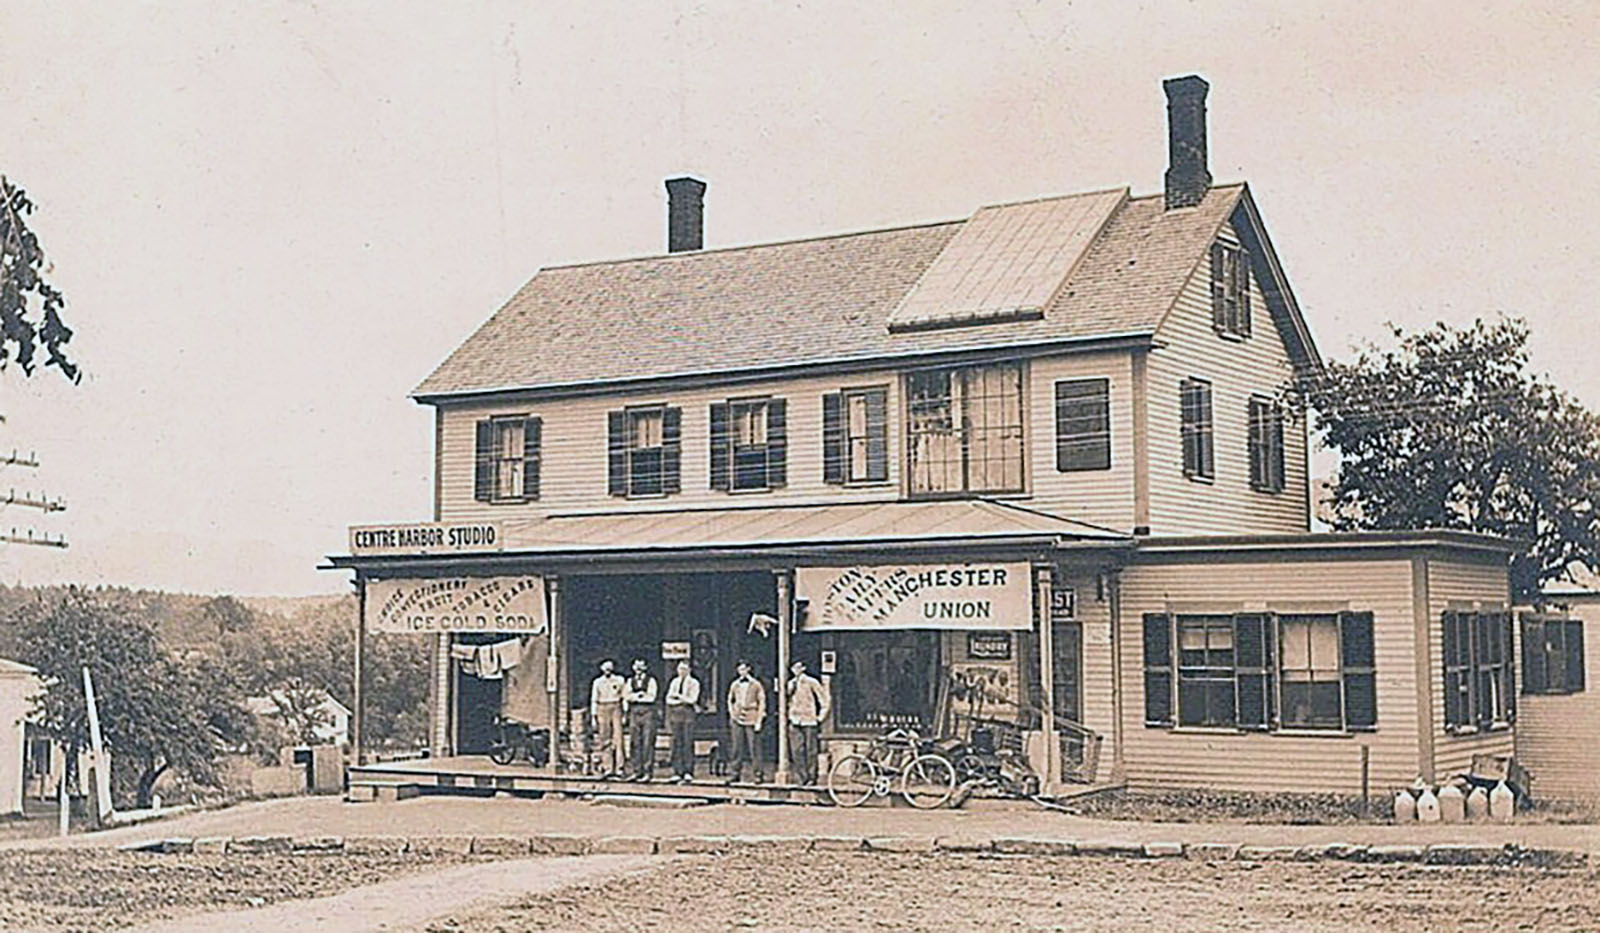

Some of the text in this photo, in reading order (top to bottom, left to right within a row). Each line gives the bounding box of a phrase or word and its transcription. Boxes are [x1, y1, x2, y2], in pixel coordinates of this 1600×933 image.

[355, 526, 496, 548] CENTRE HARBOR STUDIO
[452, 580, 501, 614] TOBACCO
[493, 579, 534, 613] CIGARS
[873, 568, 1008, 625] MANCHESTER
[923, 601, 991, 619] UNION
[407, 615, 435, 630] ICE
[440, 615, 487, 630] COLD
